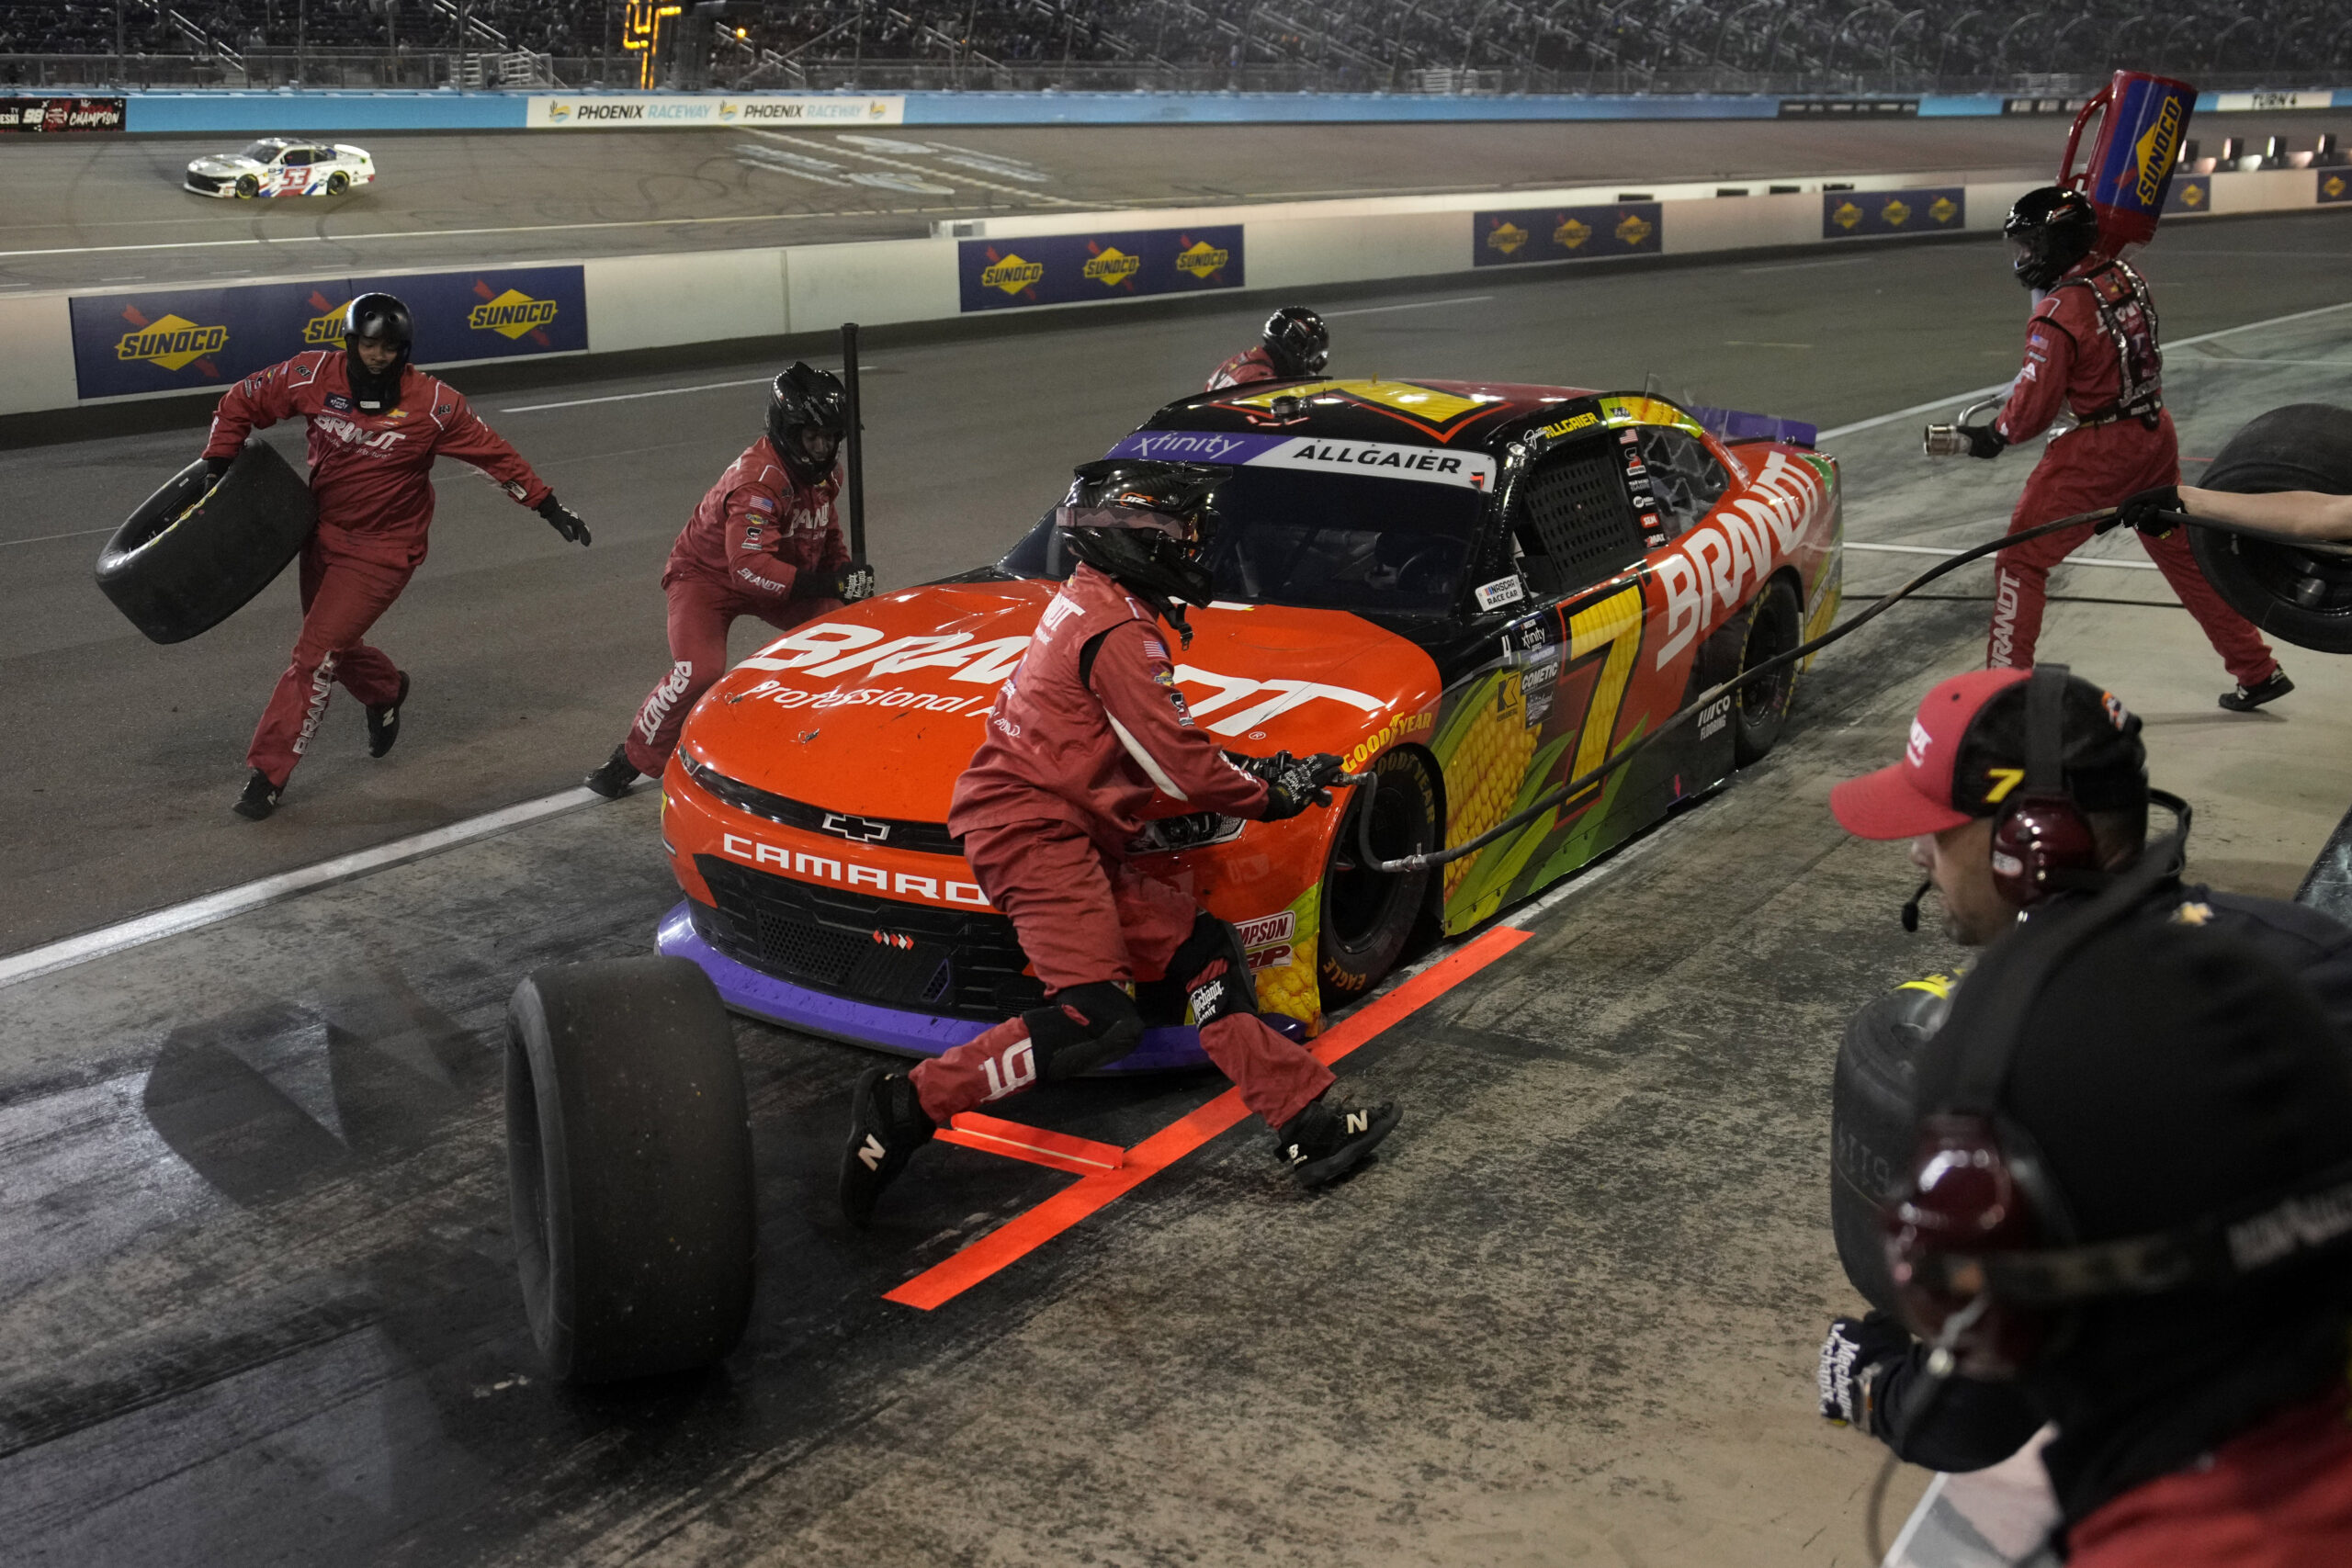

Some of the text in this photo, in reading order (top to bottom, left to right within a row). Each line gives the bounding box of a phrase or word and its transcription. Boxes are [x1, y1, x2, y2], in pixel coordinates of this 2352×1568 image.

[69, 111, 120, 127] CHAMPION
[578, 106, 712, 119] PHOENIX RACEWAY
[743, 105, 864, 118] PHOENIX RACEWAY
[2140, 98, 2182, 199] SUNOCO
[280, 168, 311, 186] 53
[985, 265, 1040, 284] SUNOCO
[1087, 257, 1137, 275] SUNOCO
[1179, 253, 1227, 269] SUNOCO
[473, 303, 553, 326] SUNOCO
[122, 330, 219, 355] SUNOCO
[1131, 432, 1244, 459] xfinity
[1293, 445, 1462, 474] ALLGAIER
[1657, 451, 1816, 672] BRANDT
[737, 568, 786, 594] BRANDT
[1491, 579, 1515, 594] NASCAR
[1487, 589, 1518, 605] RACE CAR
[1501, 634, 1512, 665] 4
[1521, 627, 1545, 649] xfinity
[1522, 662, 1558, 690] COMETIC
[638, 660, 692, 746] BRANDT
[748, 680, 983, 715] Professional
[1564, 584, 1643, 806] 7
[1341, 712, 1432, 773] GOODYEAR
[1374, 751, 1435, 824] OODYEAR
[1984, 769, 2025, 804] 7
[723, 832, 991, 907] CAMARO
[1238, 916, 1287, 945] MPSON
[1323, 957, 1367, 992] EAGLE
[1346, 1110, 1368, 1134] N
